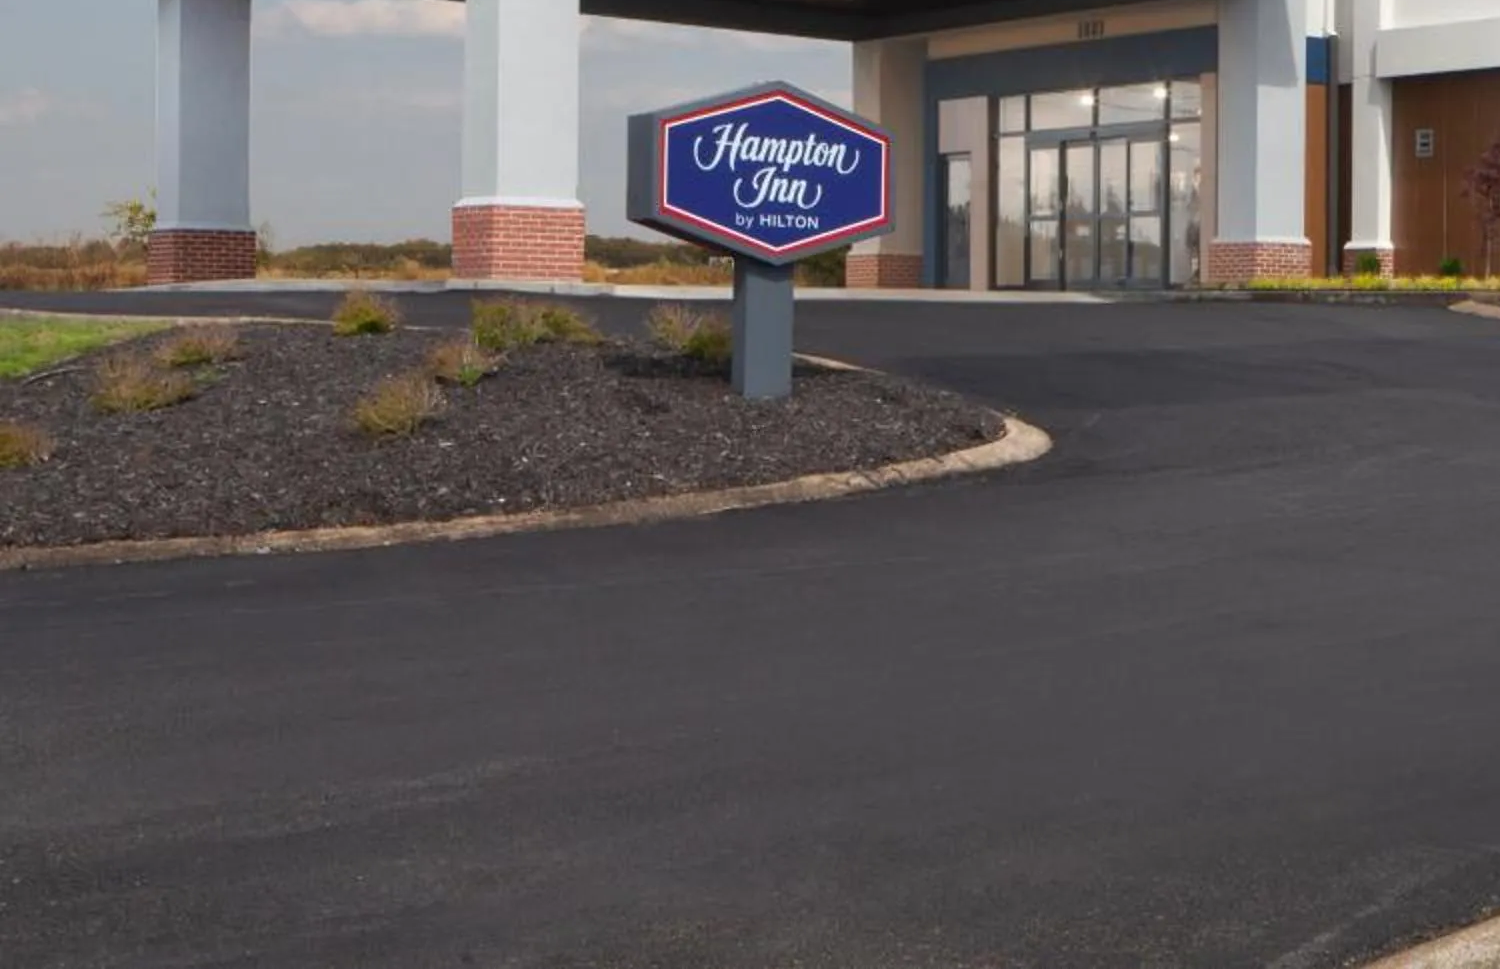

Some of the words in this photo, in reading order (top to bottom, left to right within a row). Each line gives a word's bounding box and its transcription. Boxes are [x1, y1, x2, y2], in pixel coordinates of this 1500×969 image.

[693, 122, 860, 174] Hampton
[733, 166, 822, 209] Inn
[735, 212, 754, 229] by
[759, 214, 819, 229] HILTON
